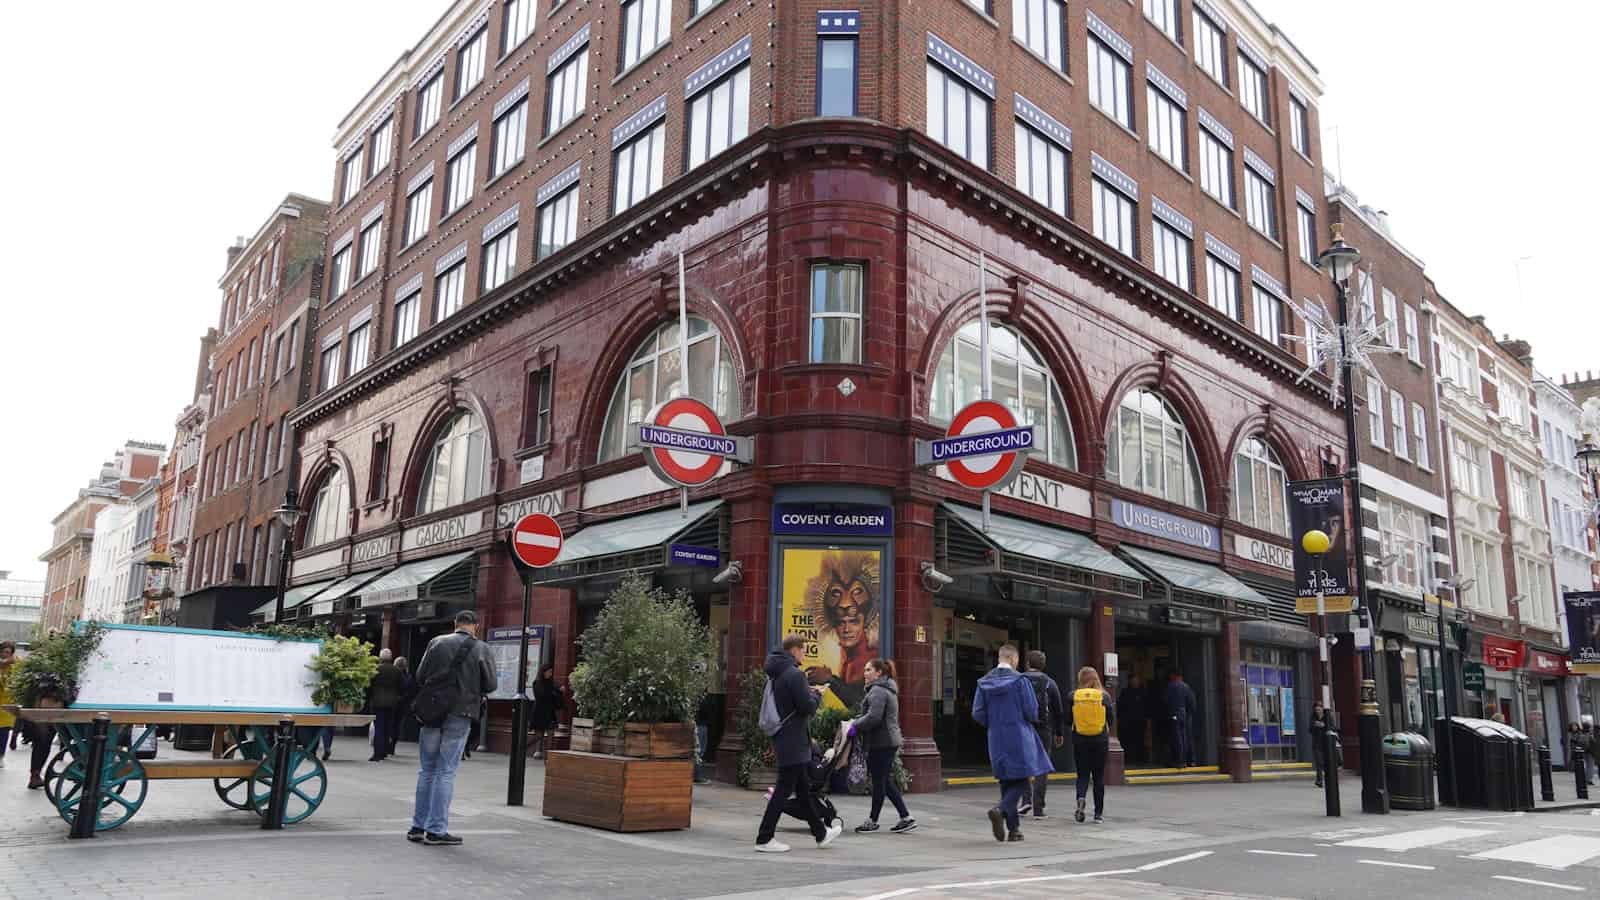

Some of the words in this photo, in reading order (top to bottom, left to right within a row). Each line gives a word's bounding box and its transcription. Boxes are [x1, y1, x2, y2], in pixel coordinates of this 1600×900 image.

[642, 428, 735, 454] UNDERGROUND
[933, 431, 1032, 458] UNDERGROUND
[1008, 474, 1064, 508] VENT
[1302, 487, 1341, 499] WOMAN
[353, 536, 392, 562] COVENT
[416, 518, 466, 546] GARDEN
[498, 494, 564, 529] STATION
[782, 514, 831, 525] COVENT
[834, 515, 885, 526] GARDEN
[1121, 502, 1212, 547] UNDERGROUND
[1251, 541, 1293, 568] GARDE
[792, 615, 814, 625] THE
